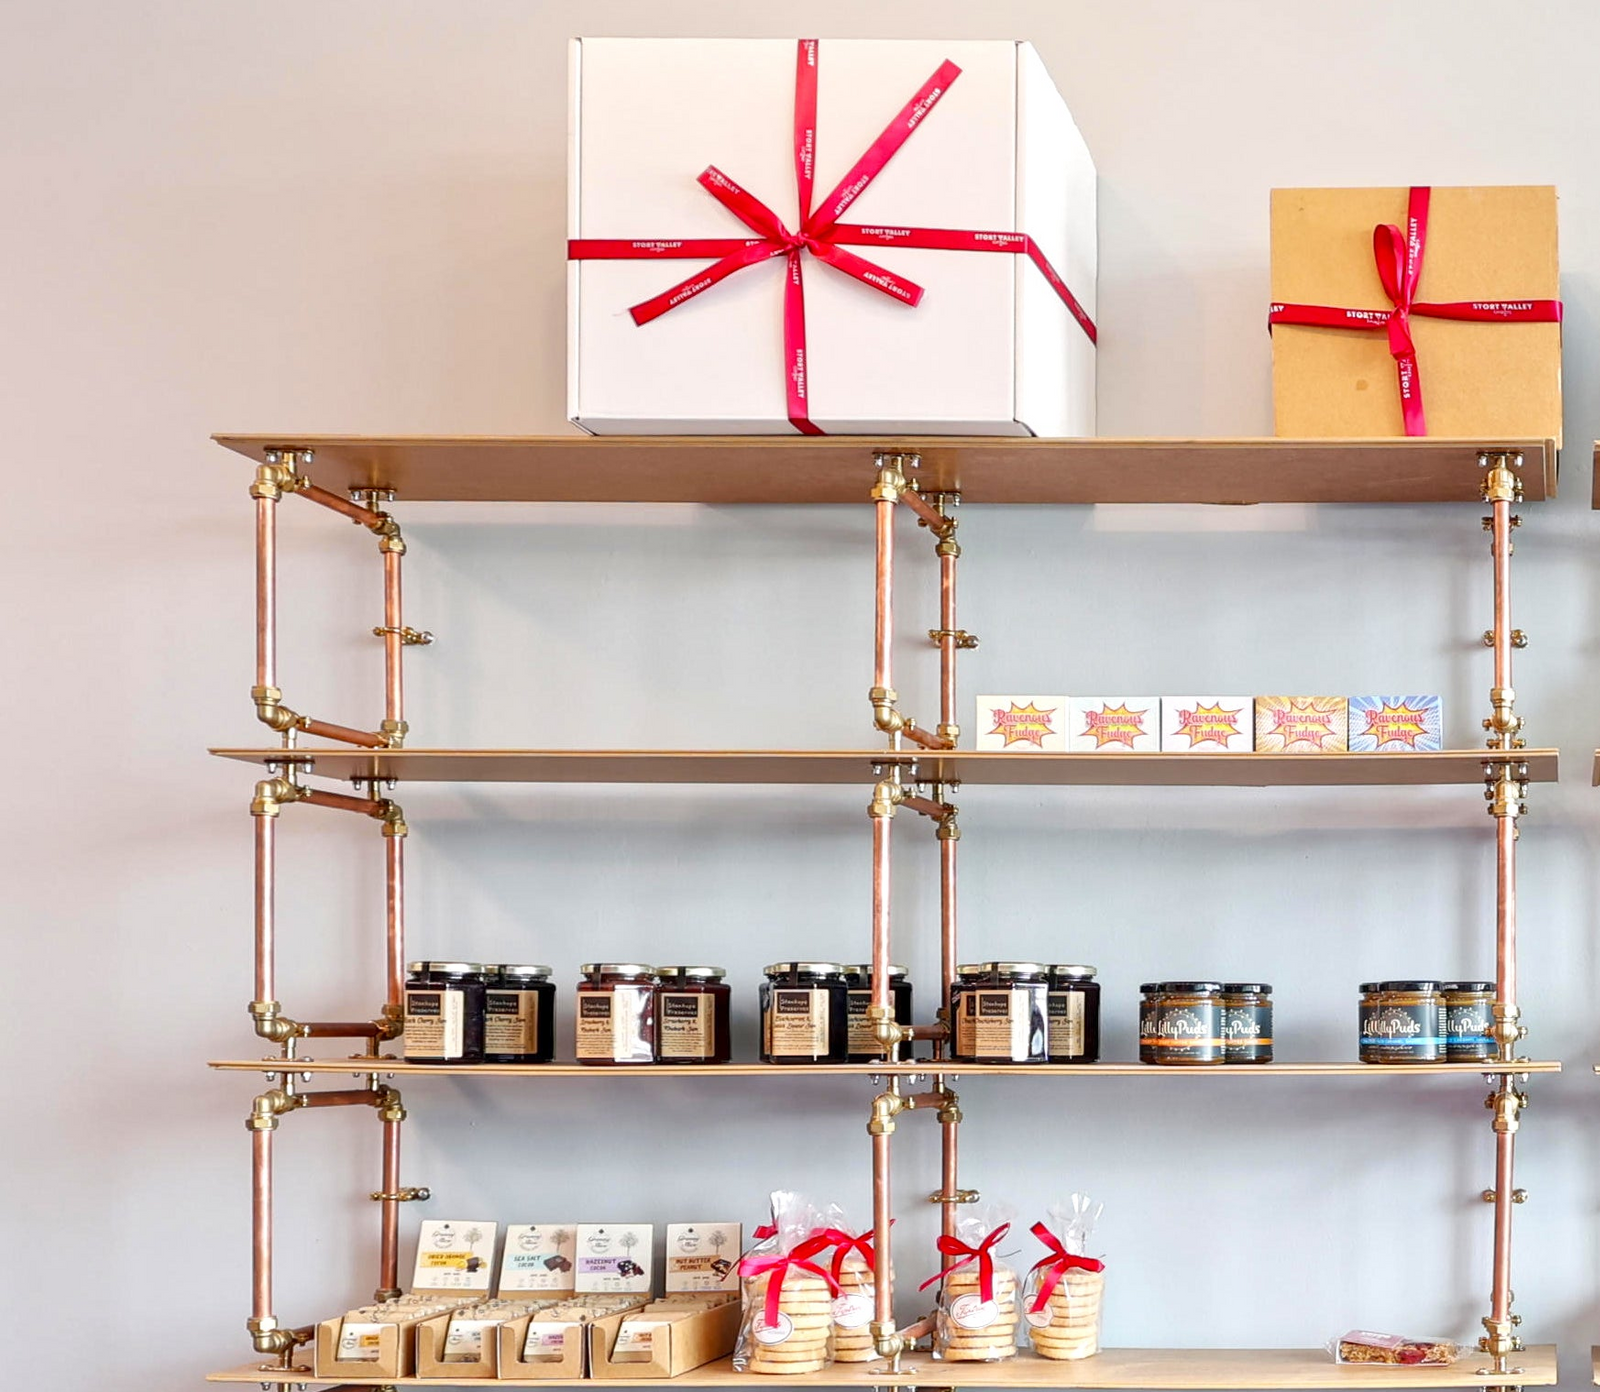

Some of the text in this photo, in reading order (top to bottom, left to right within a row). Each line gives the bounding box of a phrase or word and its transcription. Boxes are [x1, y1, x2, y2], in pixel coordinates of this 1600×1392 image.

[1473, 302, 1533, 313] STORT VALLEY
[993, 709, 1051, 725] Ravenous
[1085, 710, 1144, 726] Ravenous
[1179, 709, 1238, 725] Ravenous
[1272, 709, 1332, 725] Ravenous
[1365, 709, 1425, 725] Ravenous
[1004, 725, 1041, 741] Fudge
[1096, 726, 1133, 742] Fudge
[1189, 725, 1227, 741] Fudge
[1283, 725, 1321, 741] Fudge
[1376, 725, 1413, 741] Fudge
